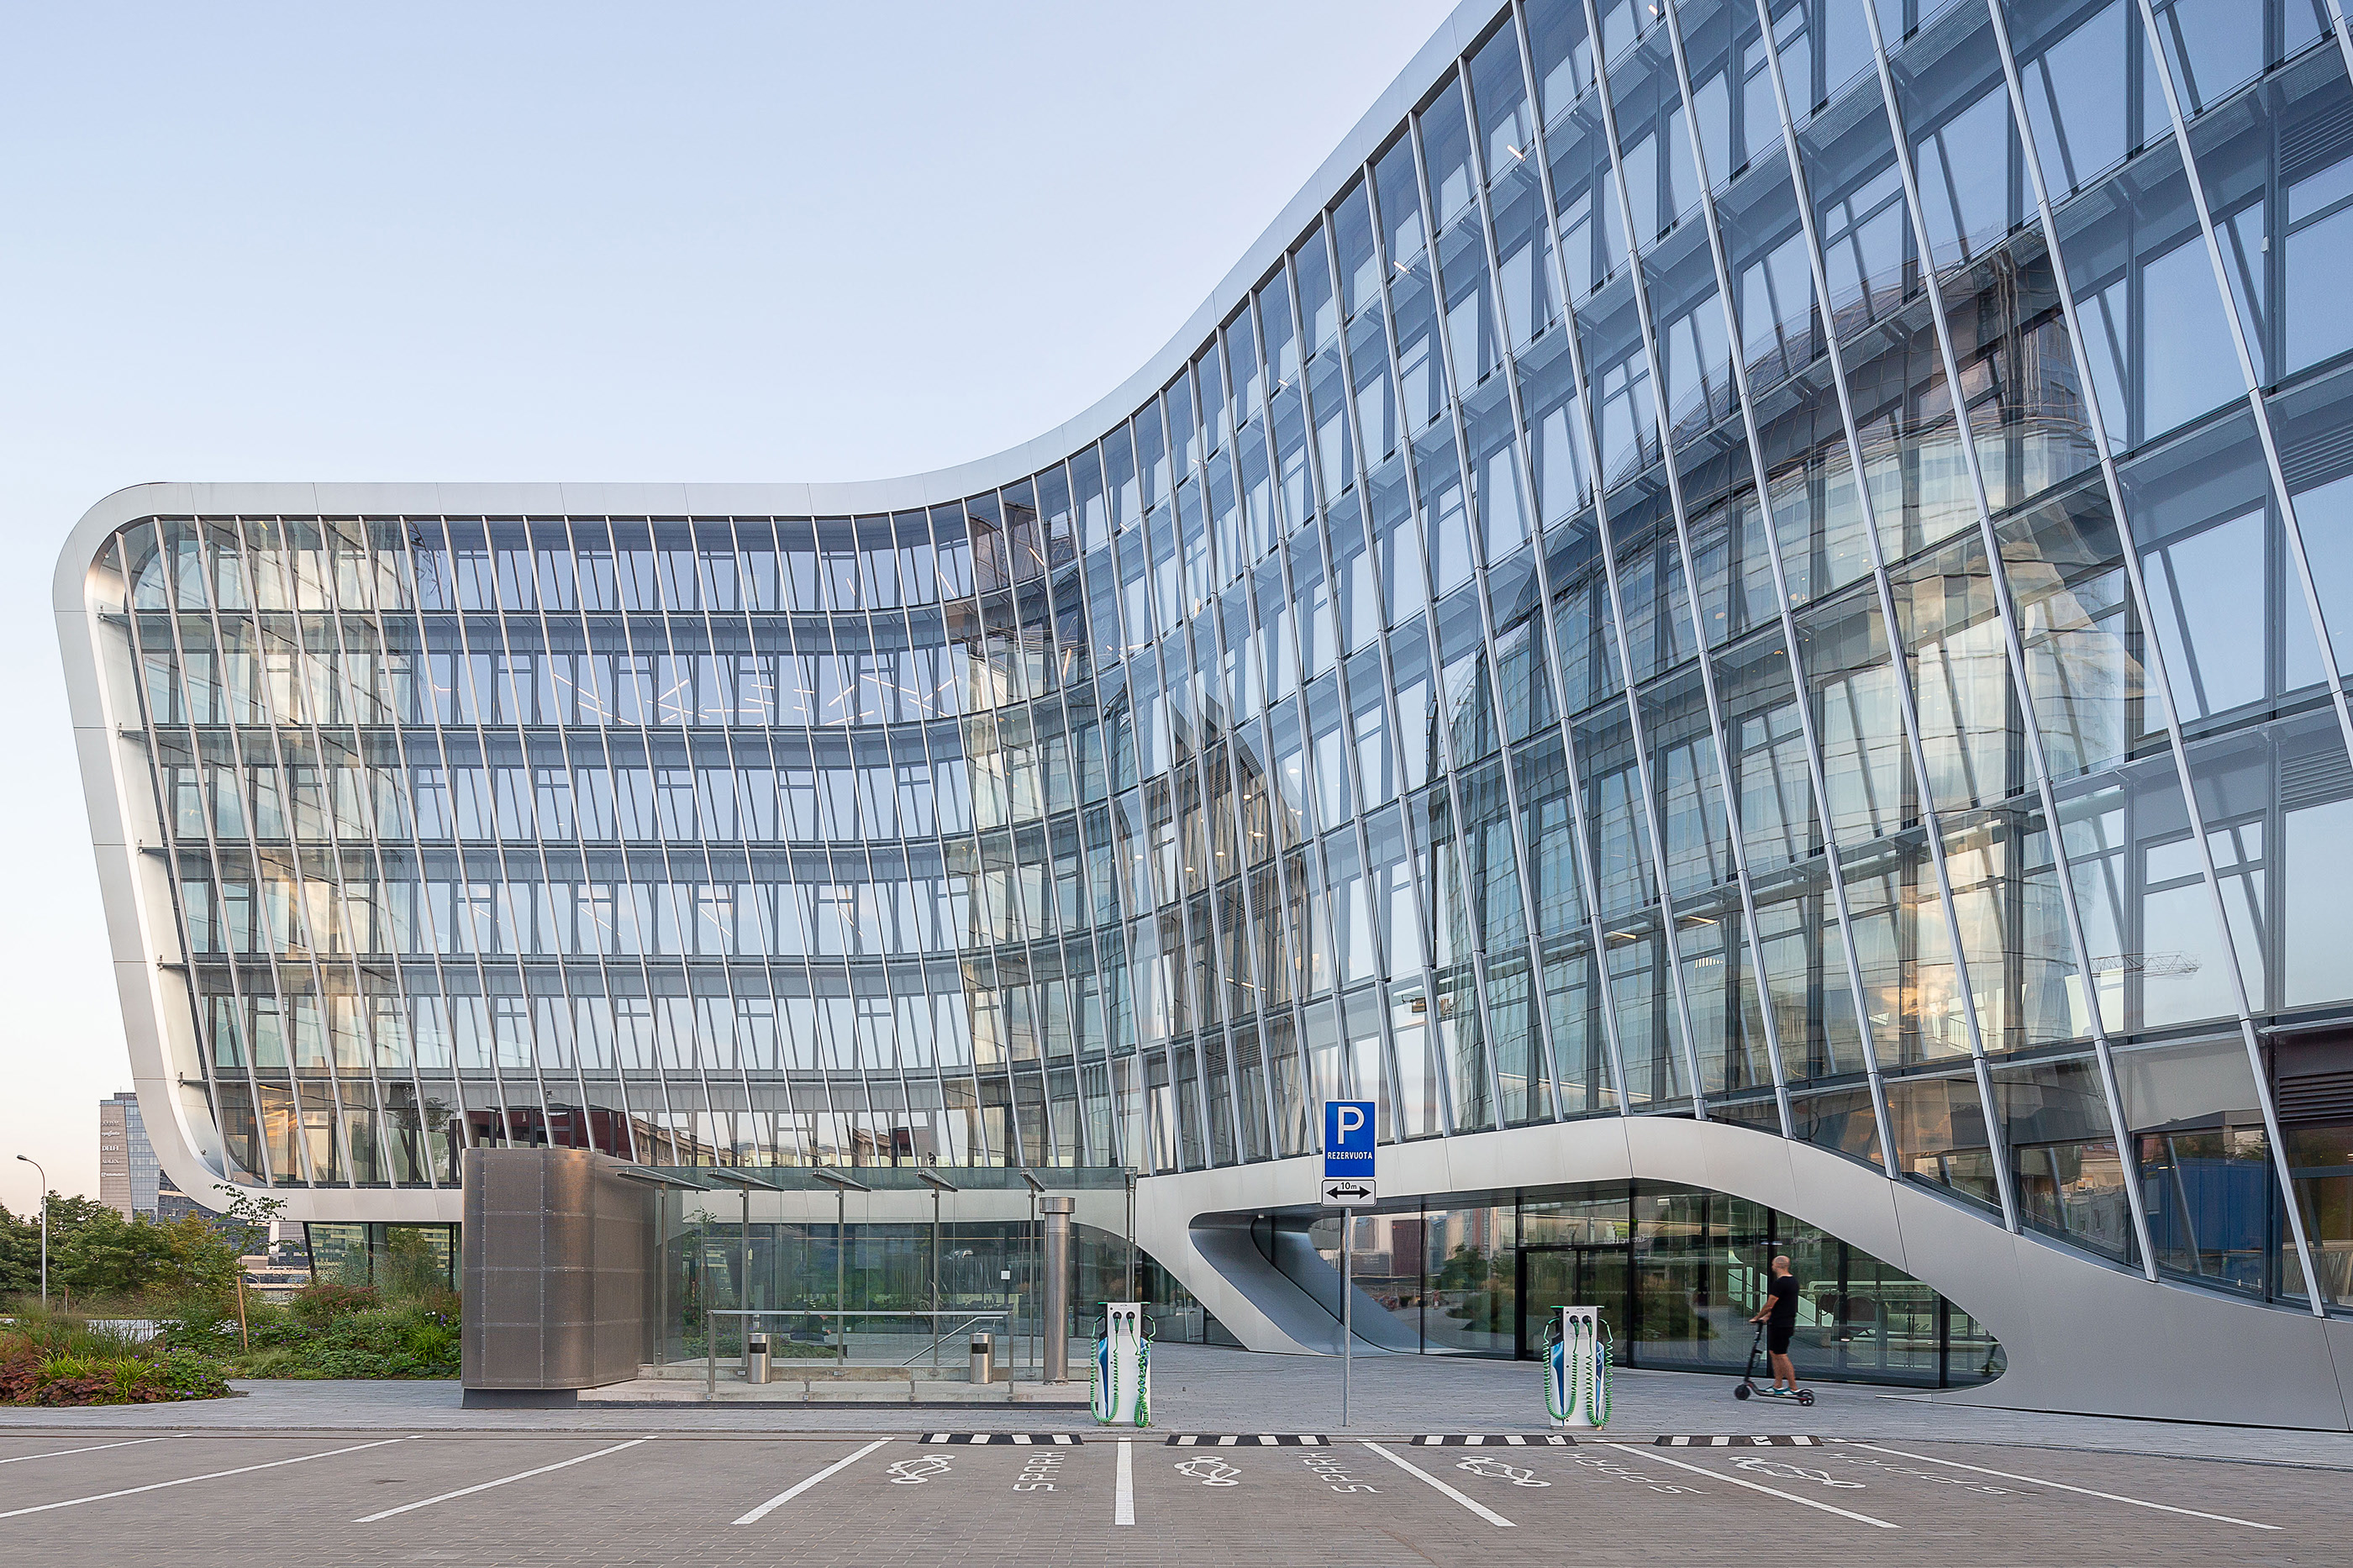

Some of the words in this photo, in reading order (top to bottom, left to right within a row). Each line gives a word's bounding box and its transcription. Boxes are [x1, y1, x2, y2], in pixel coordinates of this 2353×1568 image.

[1338, 1106, 1365, 1144] P
[1327, 1151, 1373, 1160] REZERVUOTA
[1012, 1450, 1066, 1492] SPARK
[1294, 1452, 1384, 1493] SPARK
[1553, 1452, 1711, 1494] SPARK
